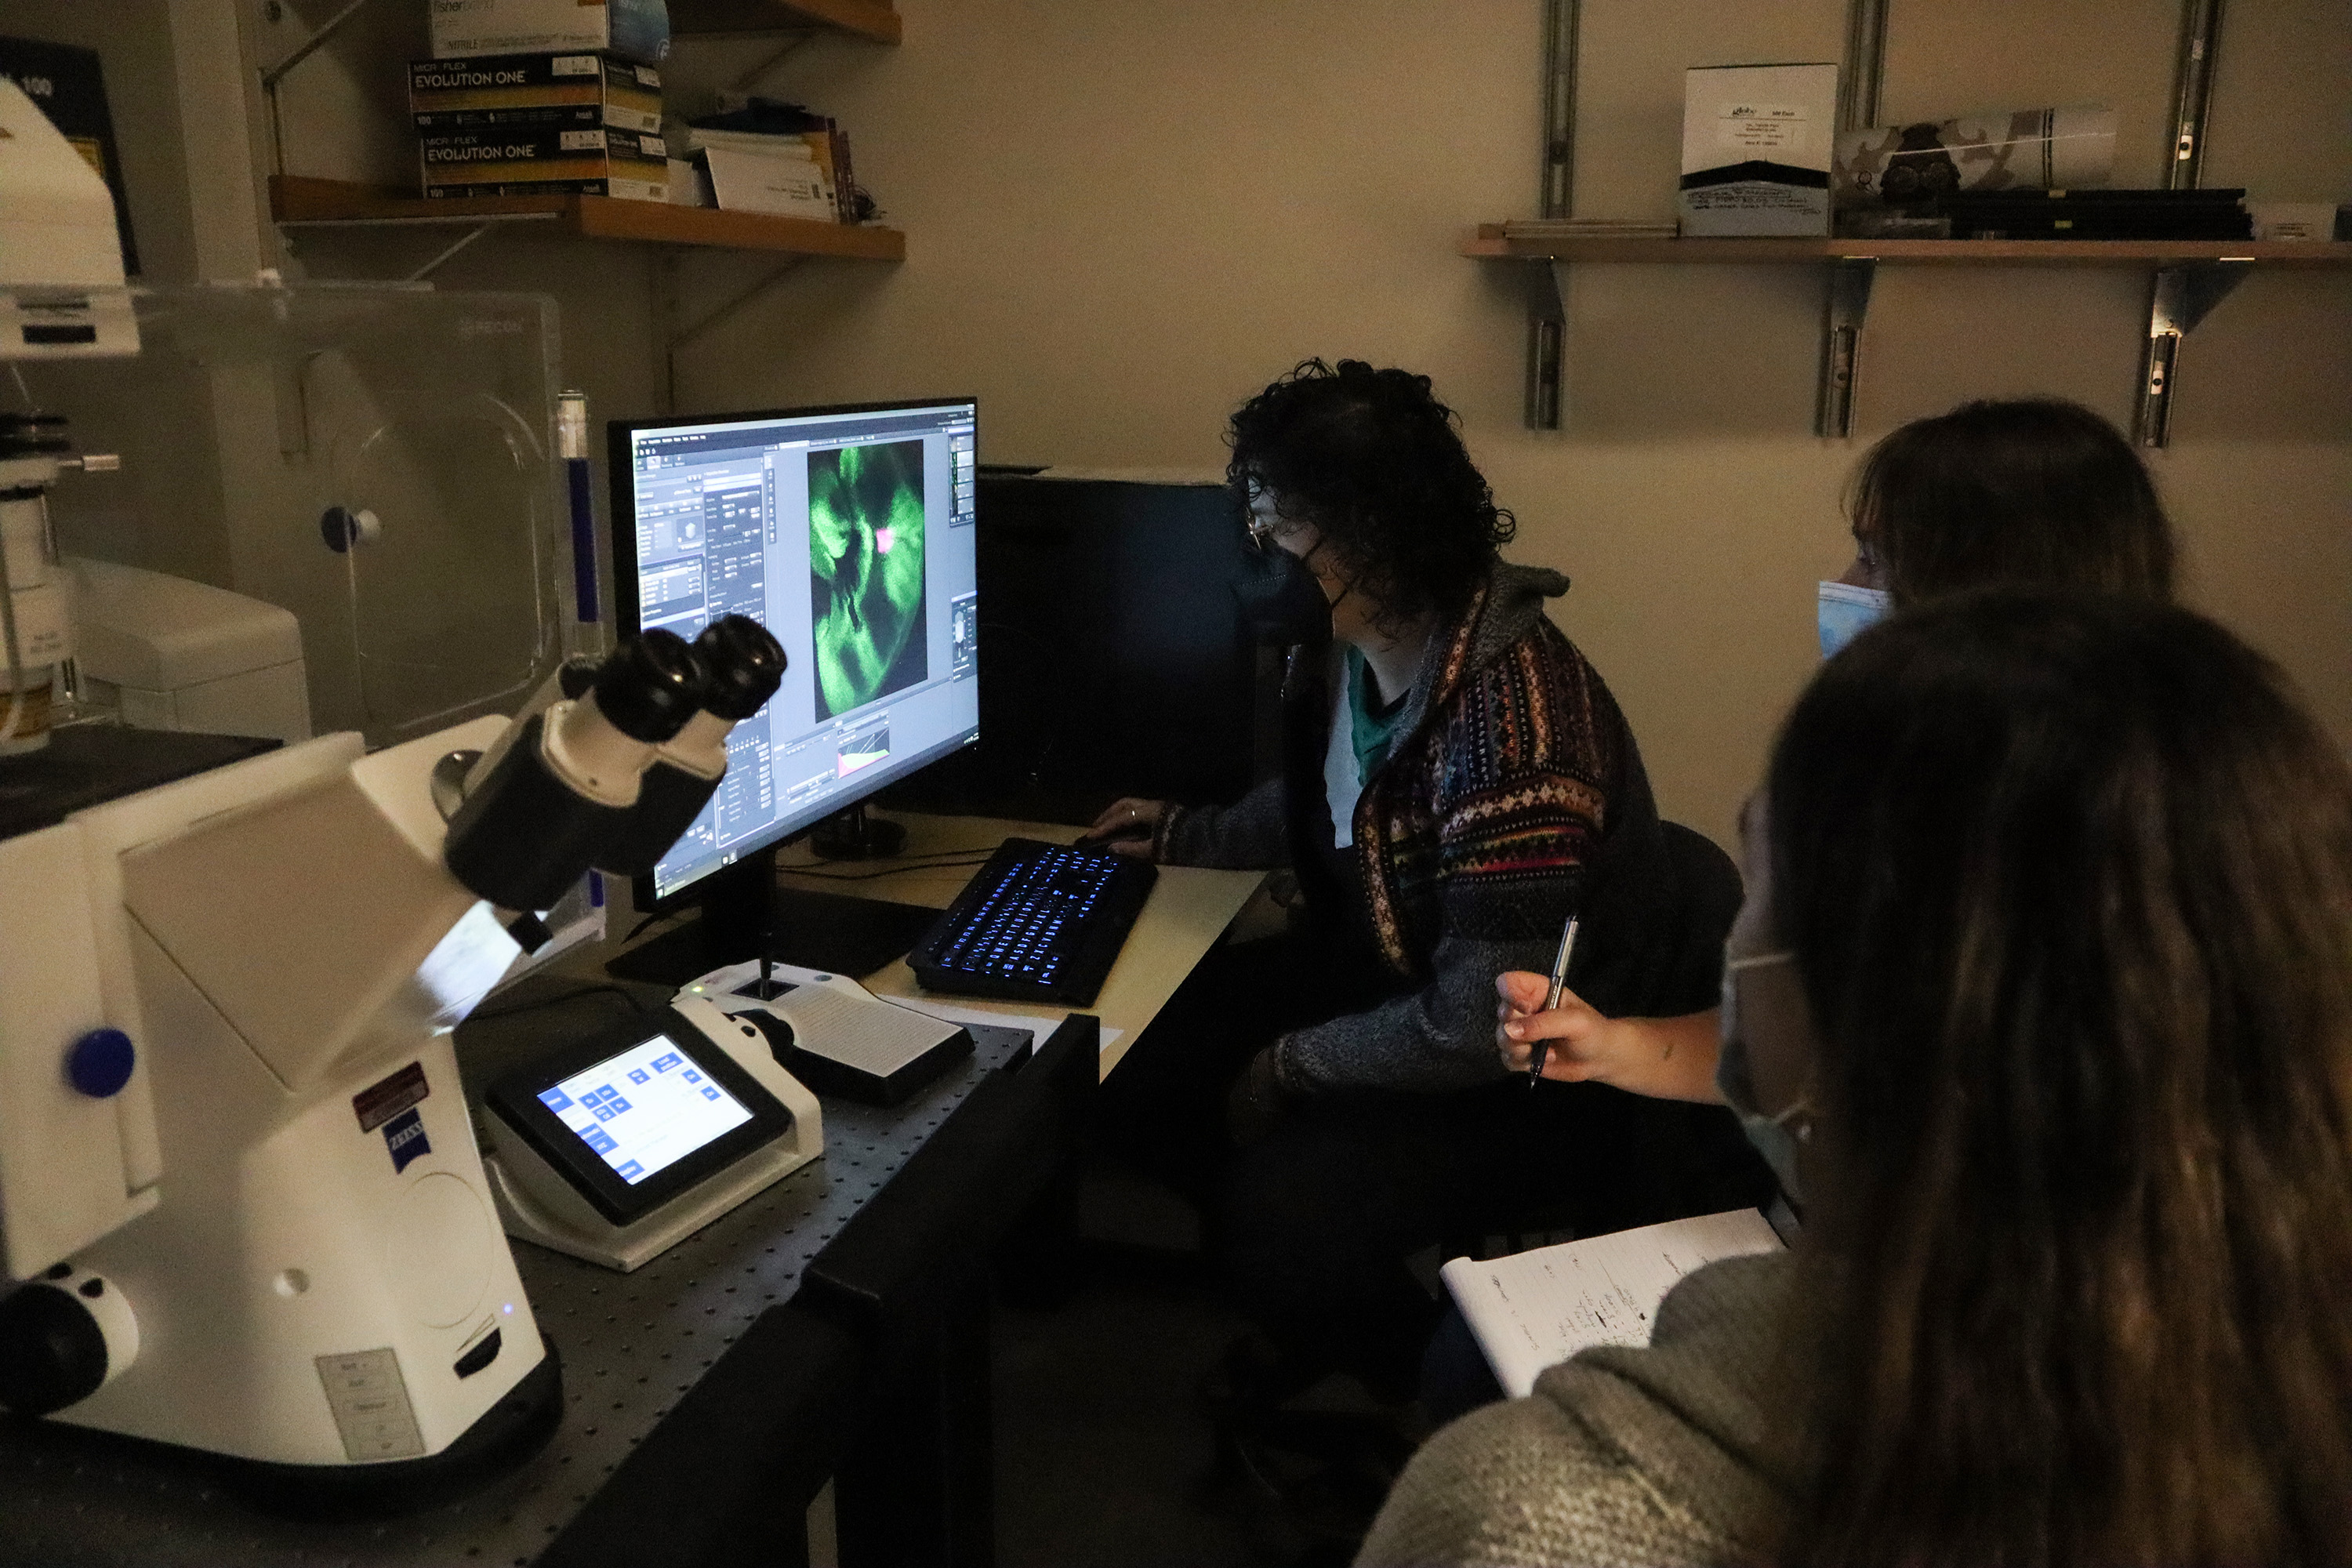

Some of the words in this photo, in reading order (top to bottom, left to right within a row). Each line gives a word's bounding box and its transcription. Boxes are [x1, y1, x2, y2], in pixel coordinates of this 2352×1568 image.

[448, 39, 479, 50] NITRILE
[416, 72, 492, 88] EVOLUTION
[495, 70, 526, 85] ONE
[428, 147, 503, 162] EVOLUTION
[506, 144, 535, 158] ONE
[389, 1120, 425, 1151] ZEISS
